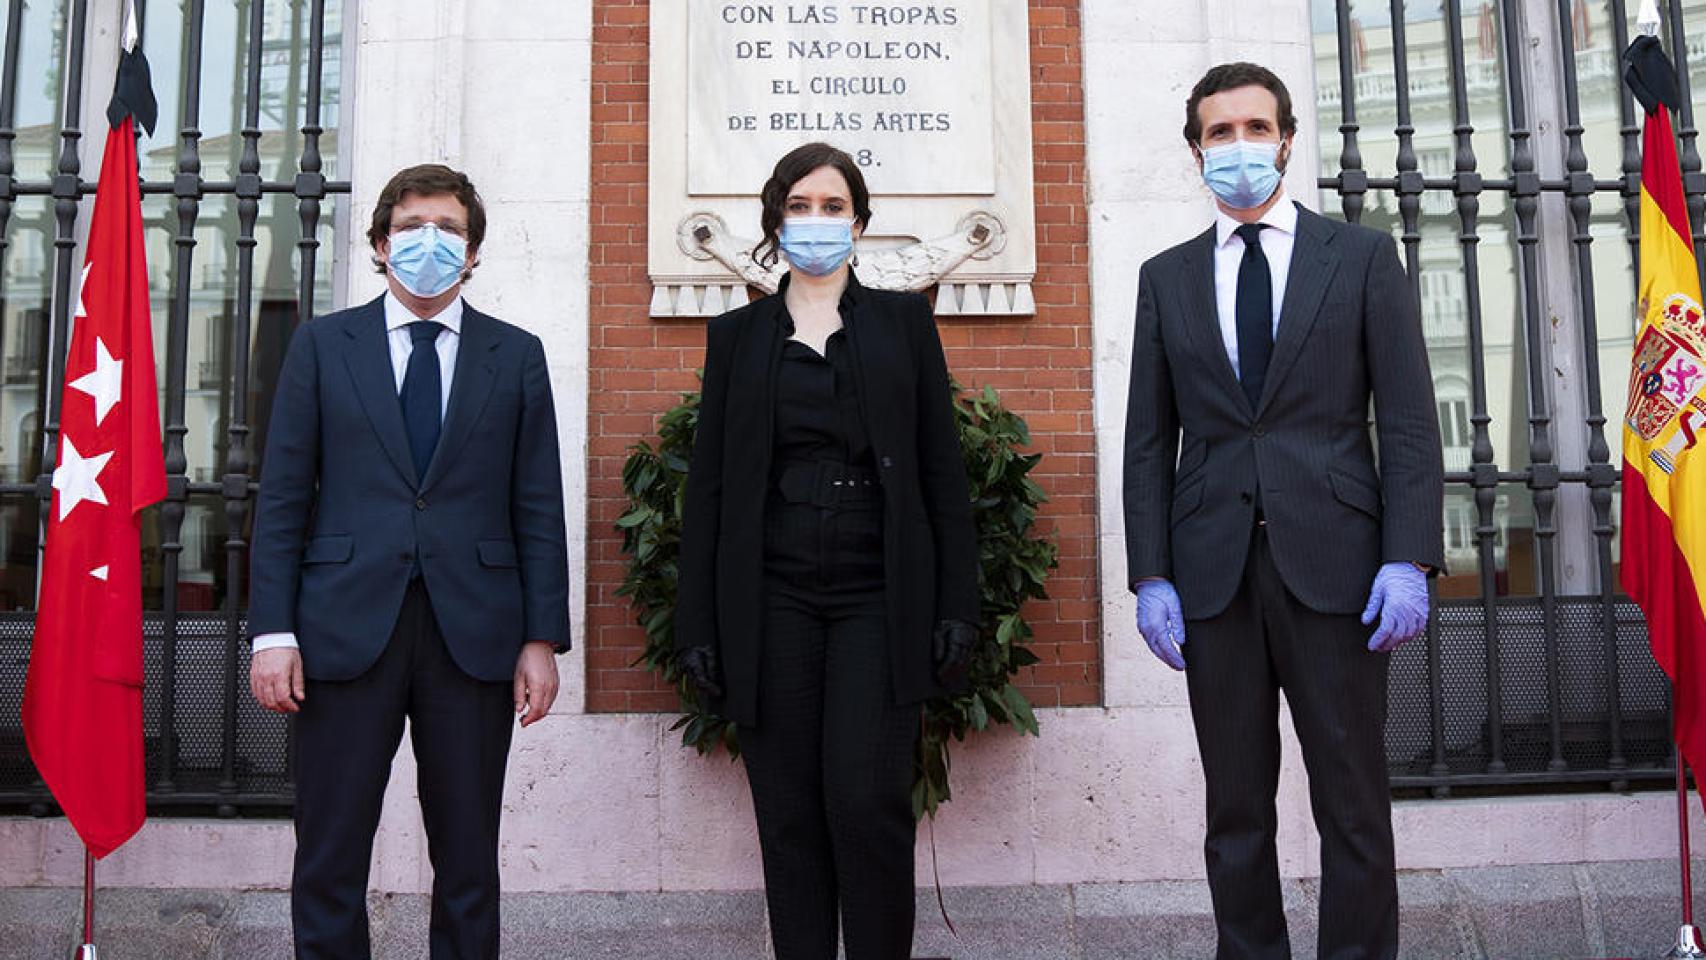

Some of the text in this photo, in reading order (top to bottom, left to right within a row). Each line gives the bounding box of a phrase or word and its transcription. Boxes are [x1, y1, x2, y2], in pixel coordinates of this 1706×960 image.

[722, 5, 958, 26] CON LAS TROPAS
[736, 41, 773, 59] DE
[771, 76, 906, 97] EL CIRCULO
[728, 112, 951, 132] DE BELLAS ARTES
